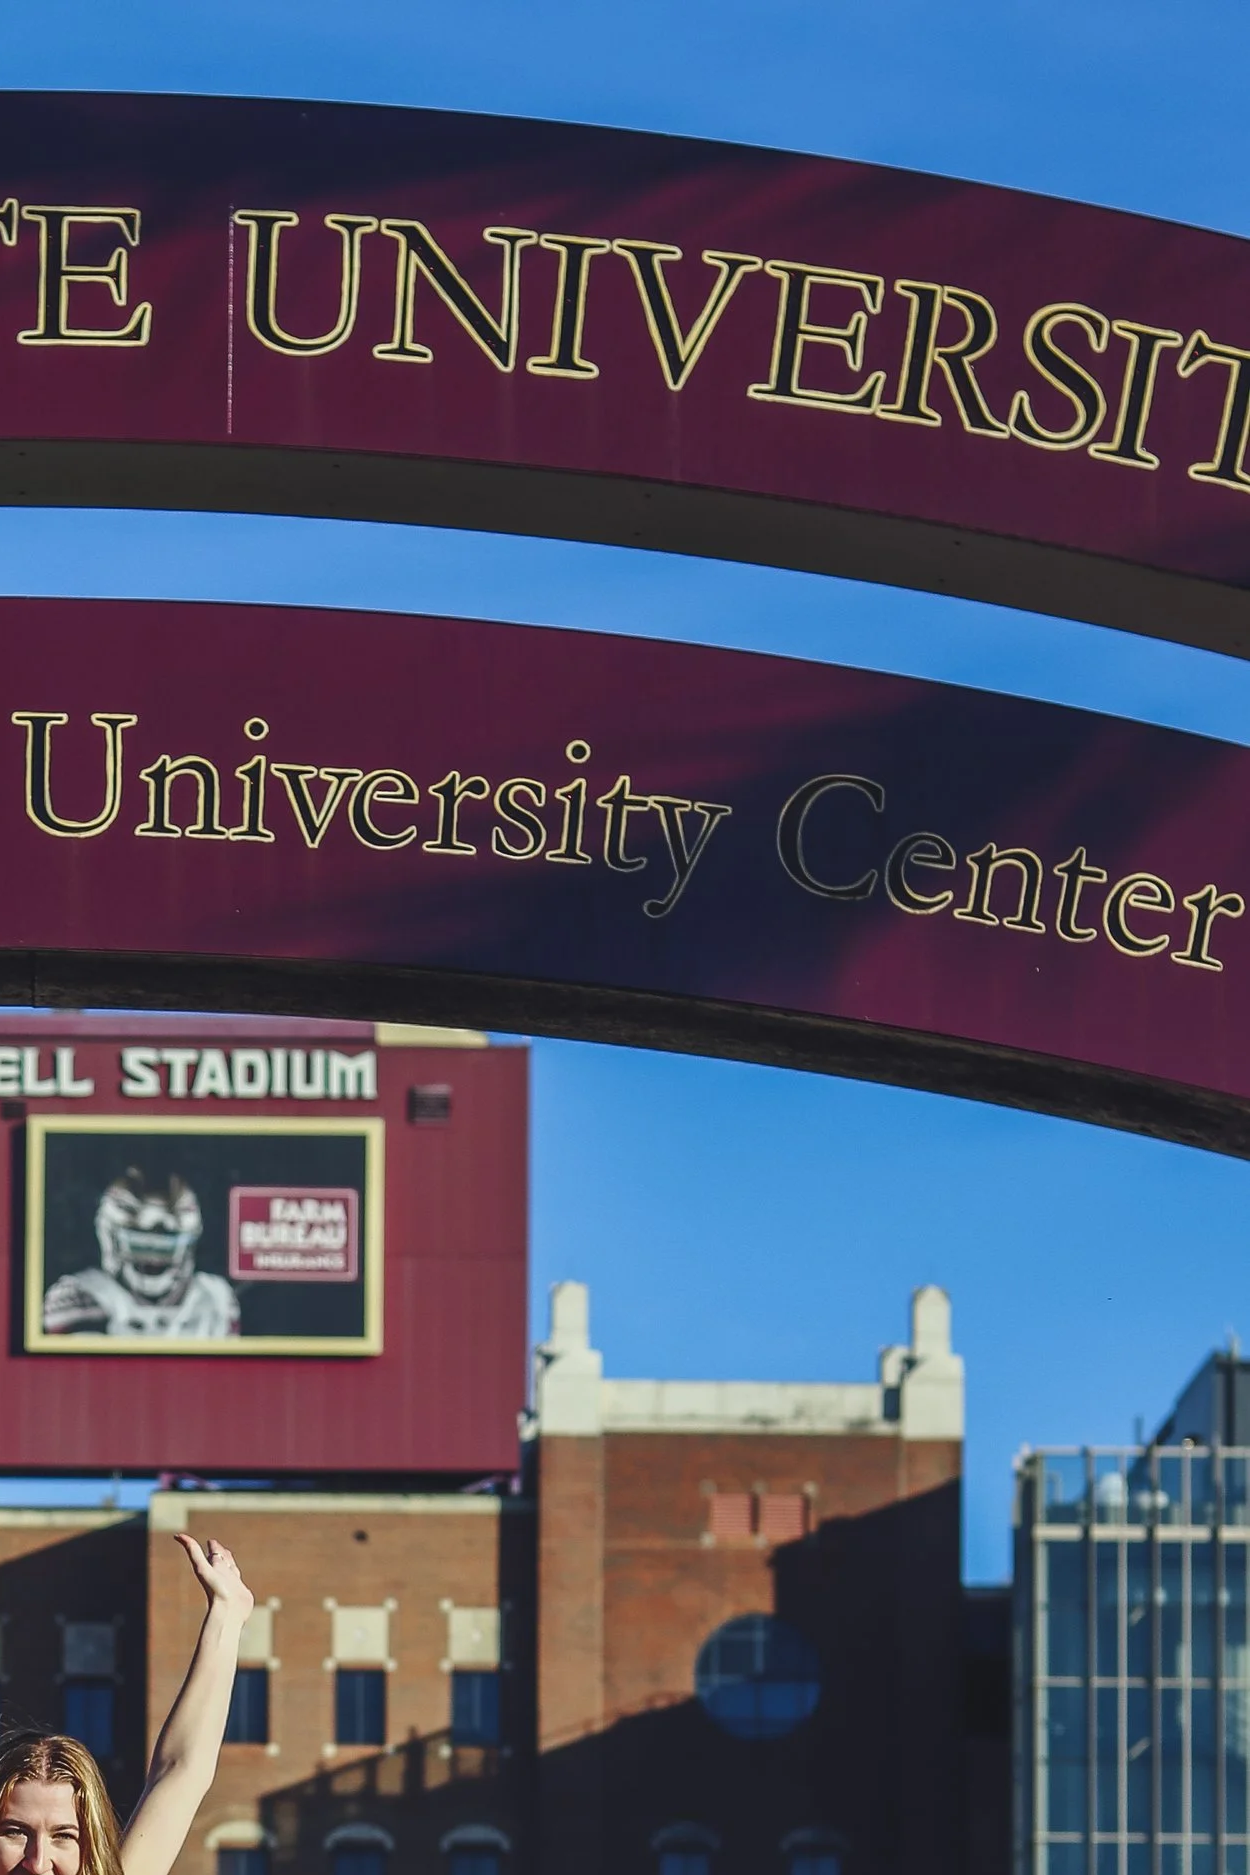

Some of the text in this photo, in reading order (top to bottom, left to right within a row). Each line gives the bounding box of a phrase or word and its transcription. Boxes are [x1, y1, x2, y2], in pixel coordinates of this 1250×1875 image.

[11, 711, 733, 919] University
[776, 774, 1245, 972] Center
[121, 1047, 378, 1100] STADIUM
[269, 1198, 347, 1222] FARM
[240, 1221, 347, 1249] BUREAU
